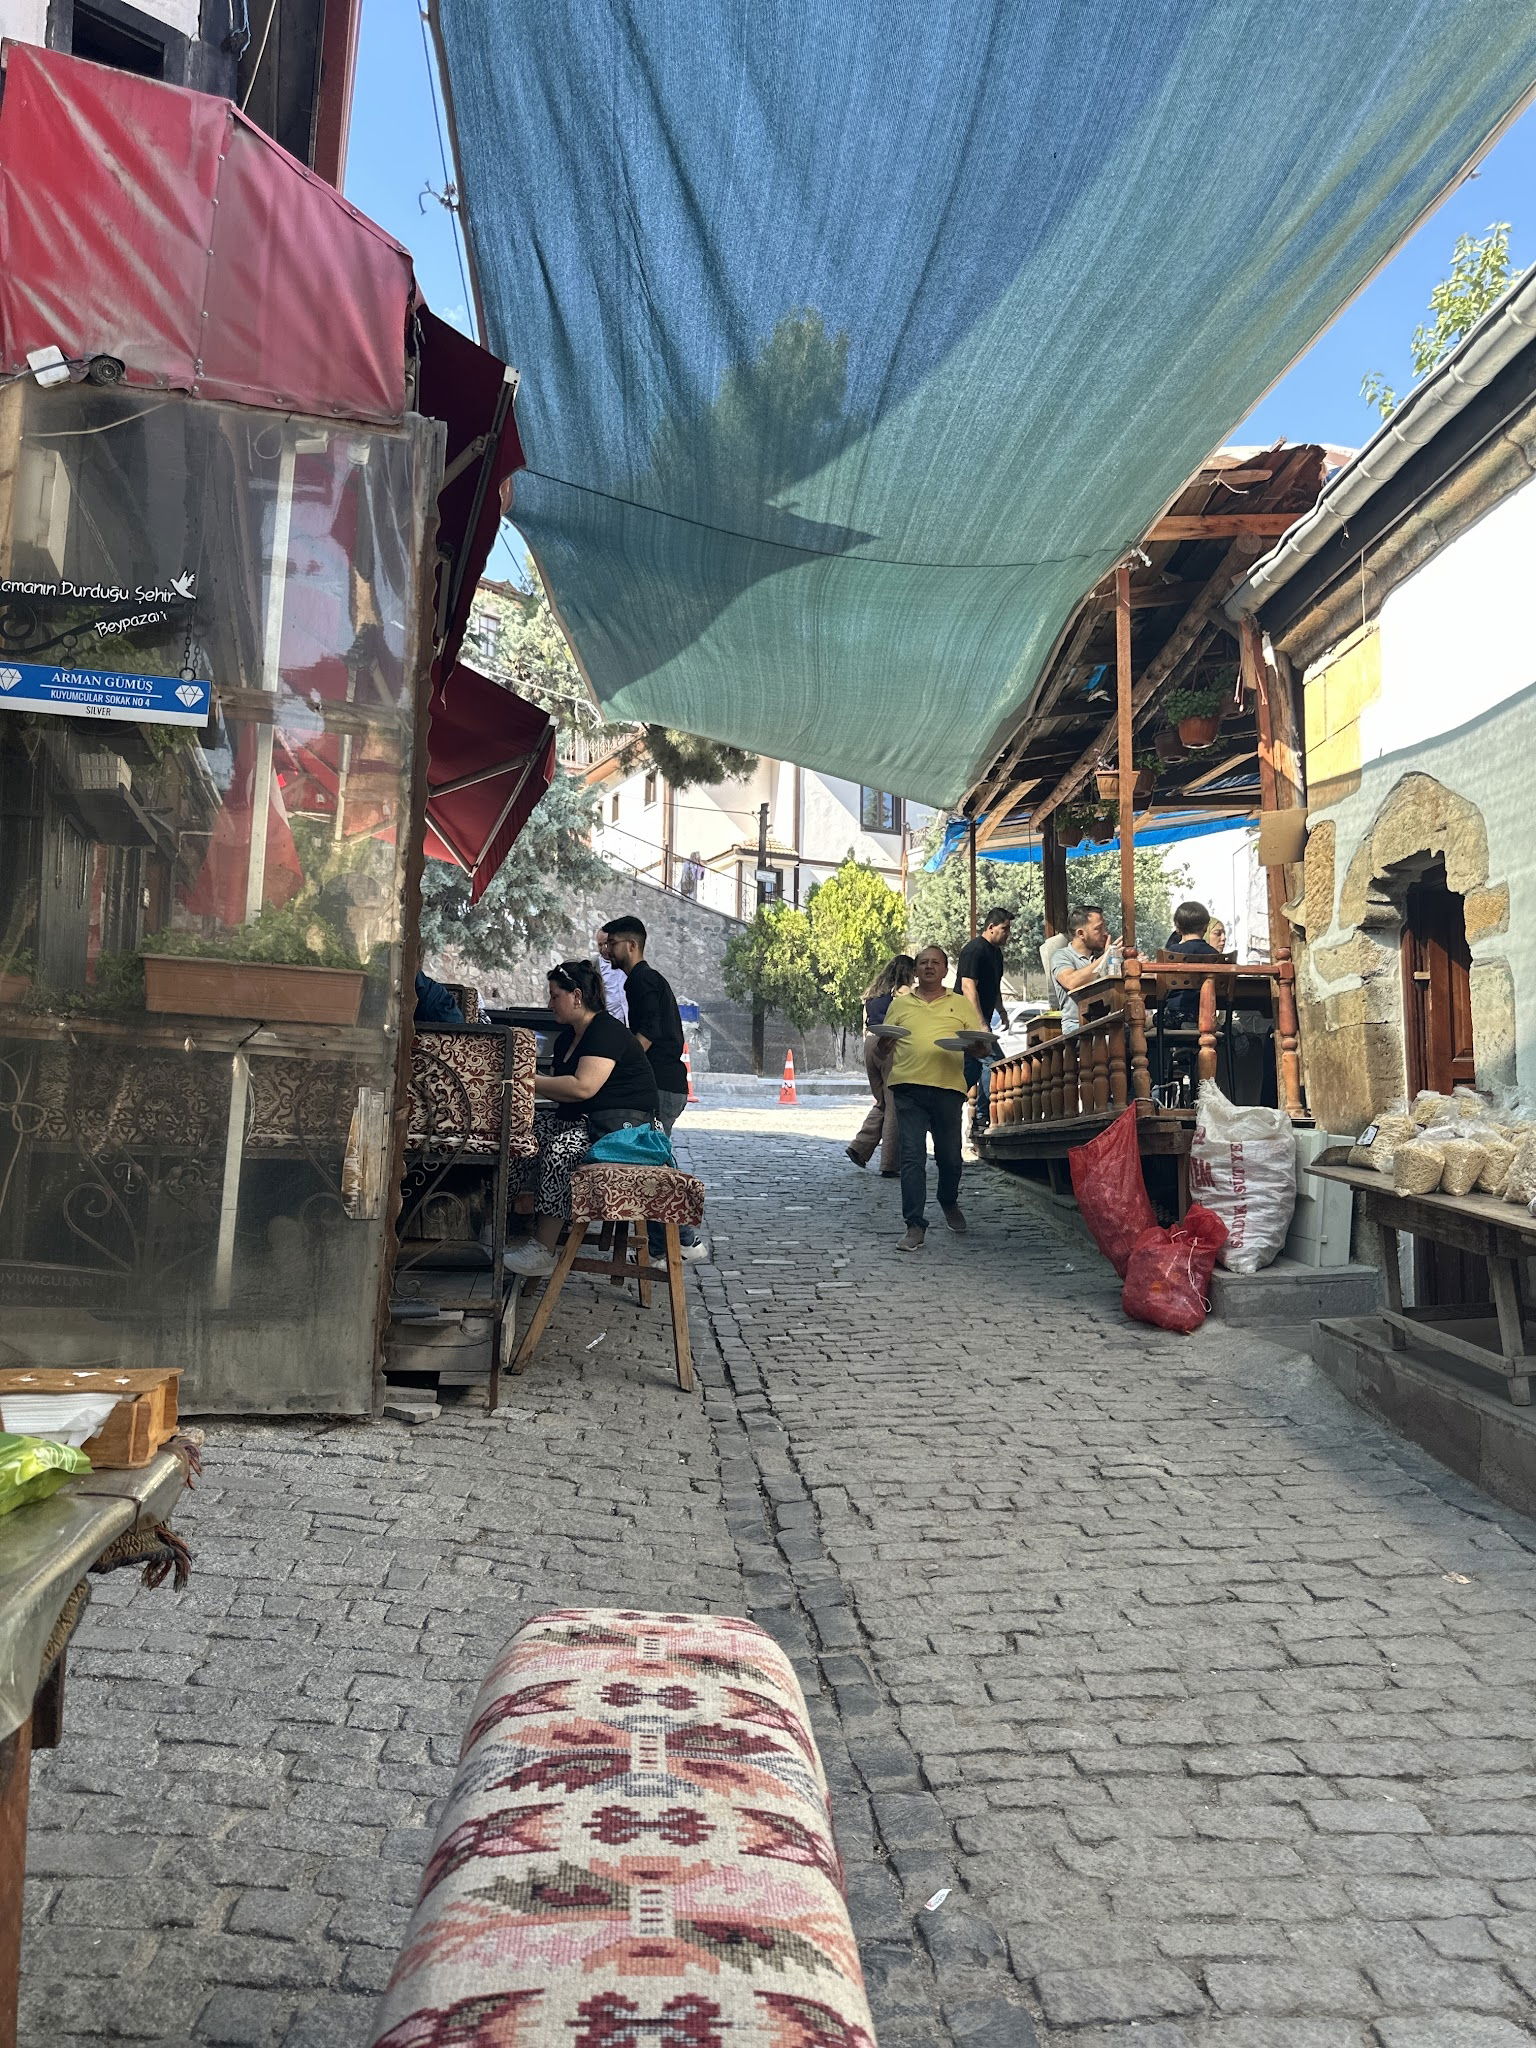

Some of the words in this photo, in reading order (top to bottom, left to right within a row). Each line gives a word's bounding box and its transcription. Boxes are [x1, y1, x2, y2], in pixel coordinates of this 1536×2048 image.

[0, 580, 56, 597] amanın
[60, 580, 129, 603] Durduğu
[134, 585, 177, 605] Şehir
[51, 672, 102, 686] ARMAN
[104, 676, 153, 693] GÜMÜŞ
[50, 689, 103, 704] KUYUMCULAR
[105, 694, 131, 706] SOKAK
[132, 698, 143, 707] NO
[144, 698, 151, 708] 4
[85, 705, 112, 717] SILVER
[1230, 1204, 1248, 1248] SADIK
